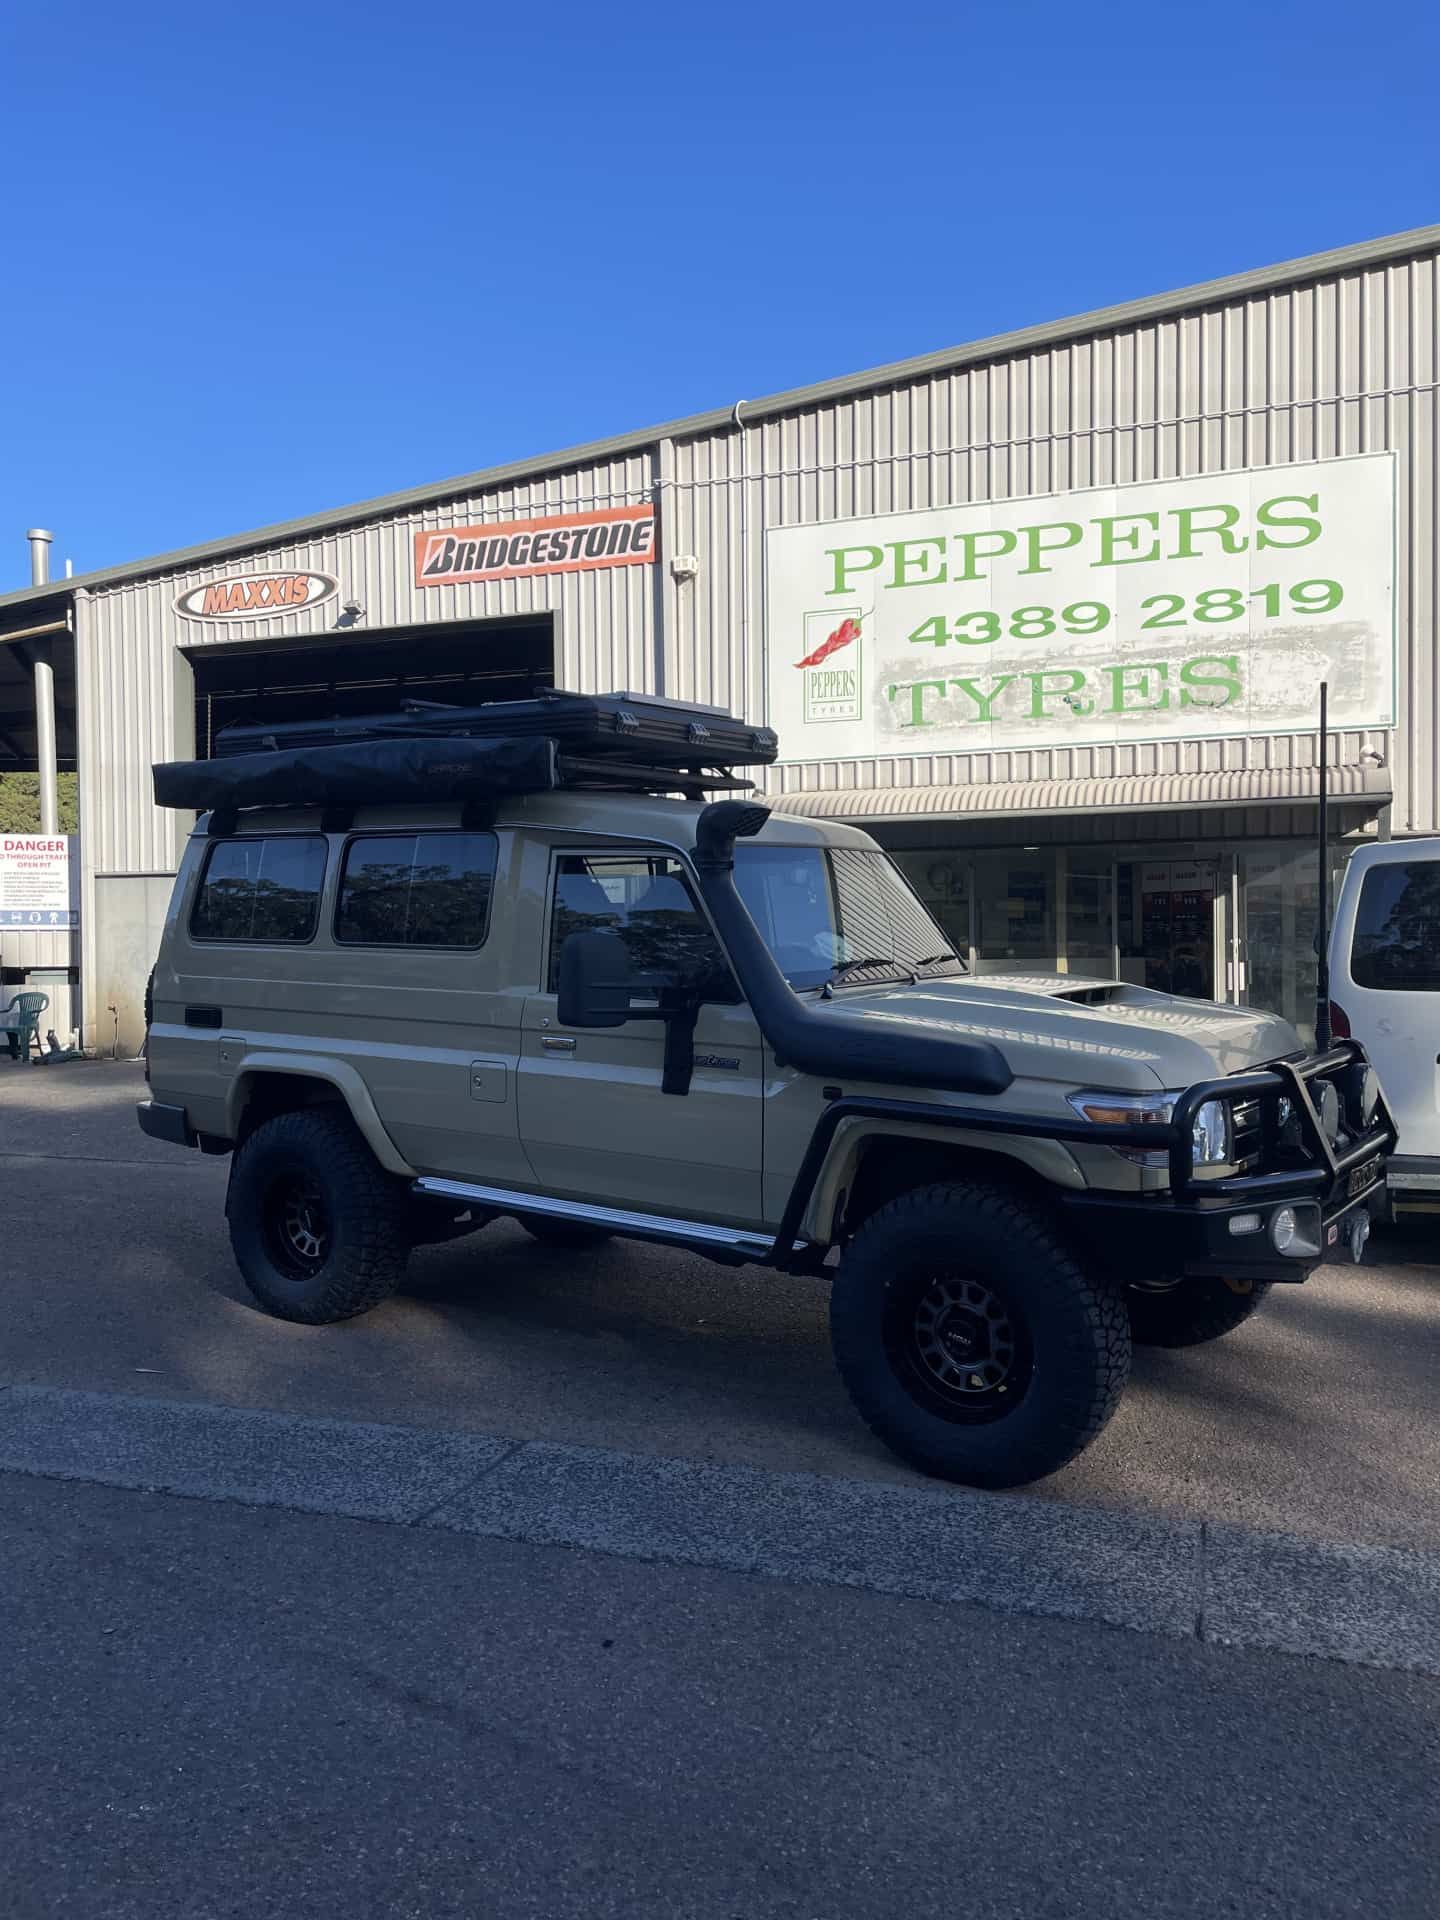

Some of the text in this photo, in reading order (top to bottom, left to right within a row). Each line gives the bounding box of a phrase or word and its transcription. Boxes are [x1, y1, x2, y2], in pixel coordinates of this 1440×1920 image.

[423, 519, 653, 575] BRIDGESTONE
[823, 492, 1322, 595] PEPPERS
[202, 575, 309, 615] MAXXIS
[907, 578, 1345, 648] 4389 2819
[811, 670, 856, 699] PEPPERS
[888, 655, 1243, 727] TYRES
[4, 840, 65, 851] DANGER
